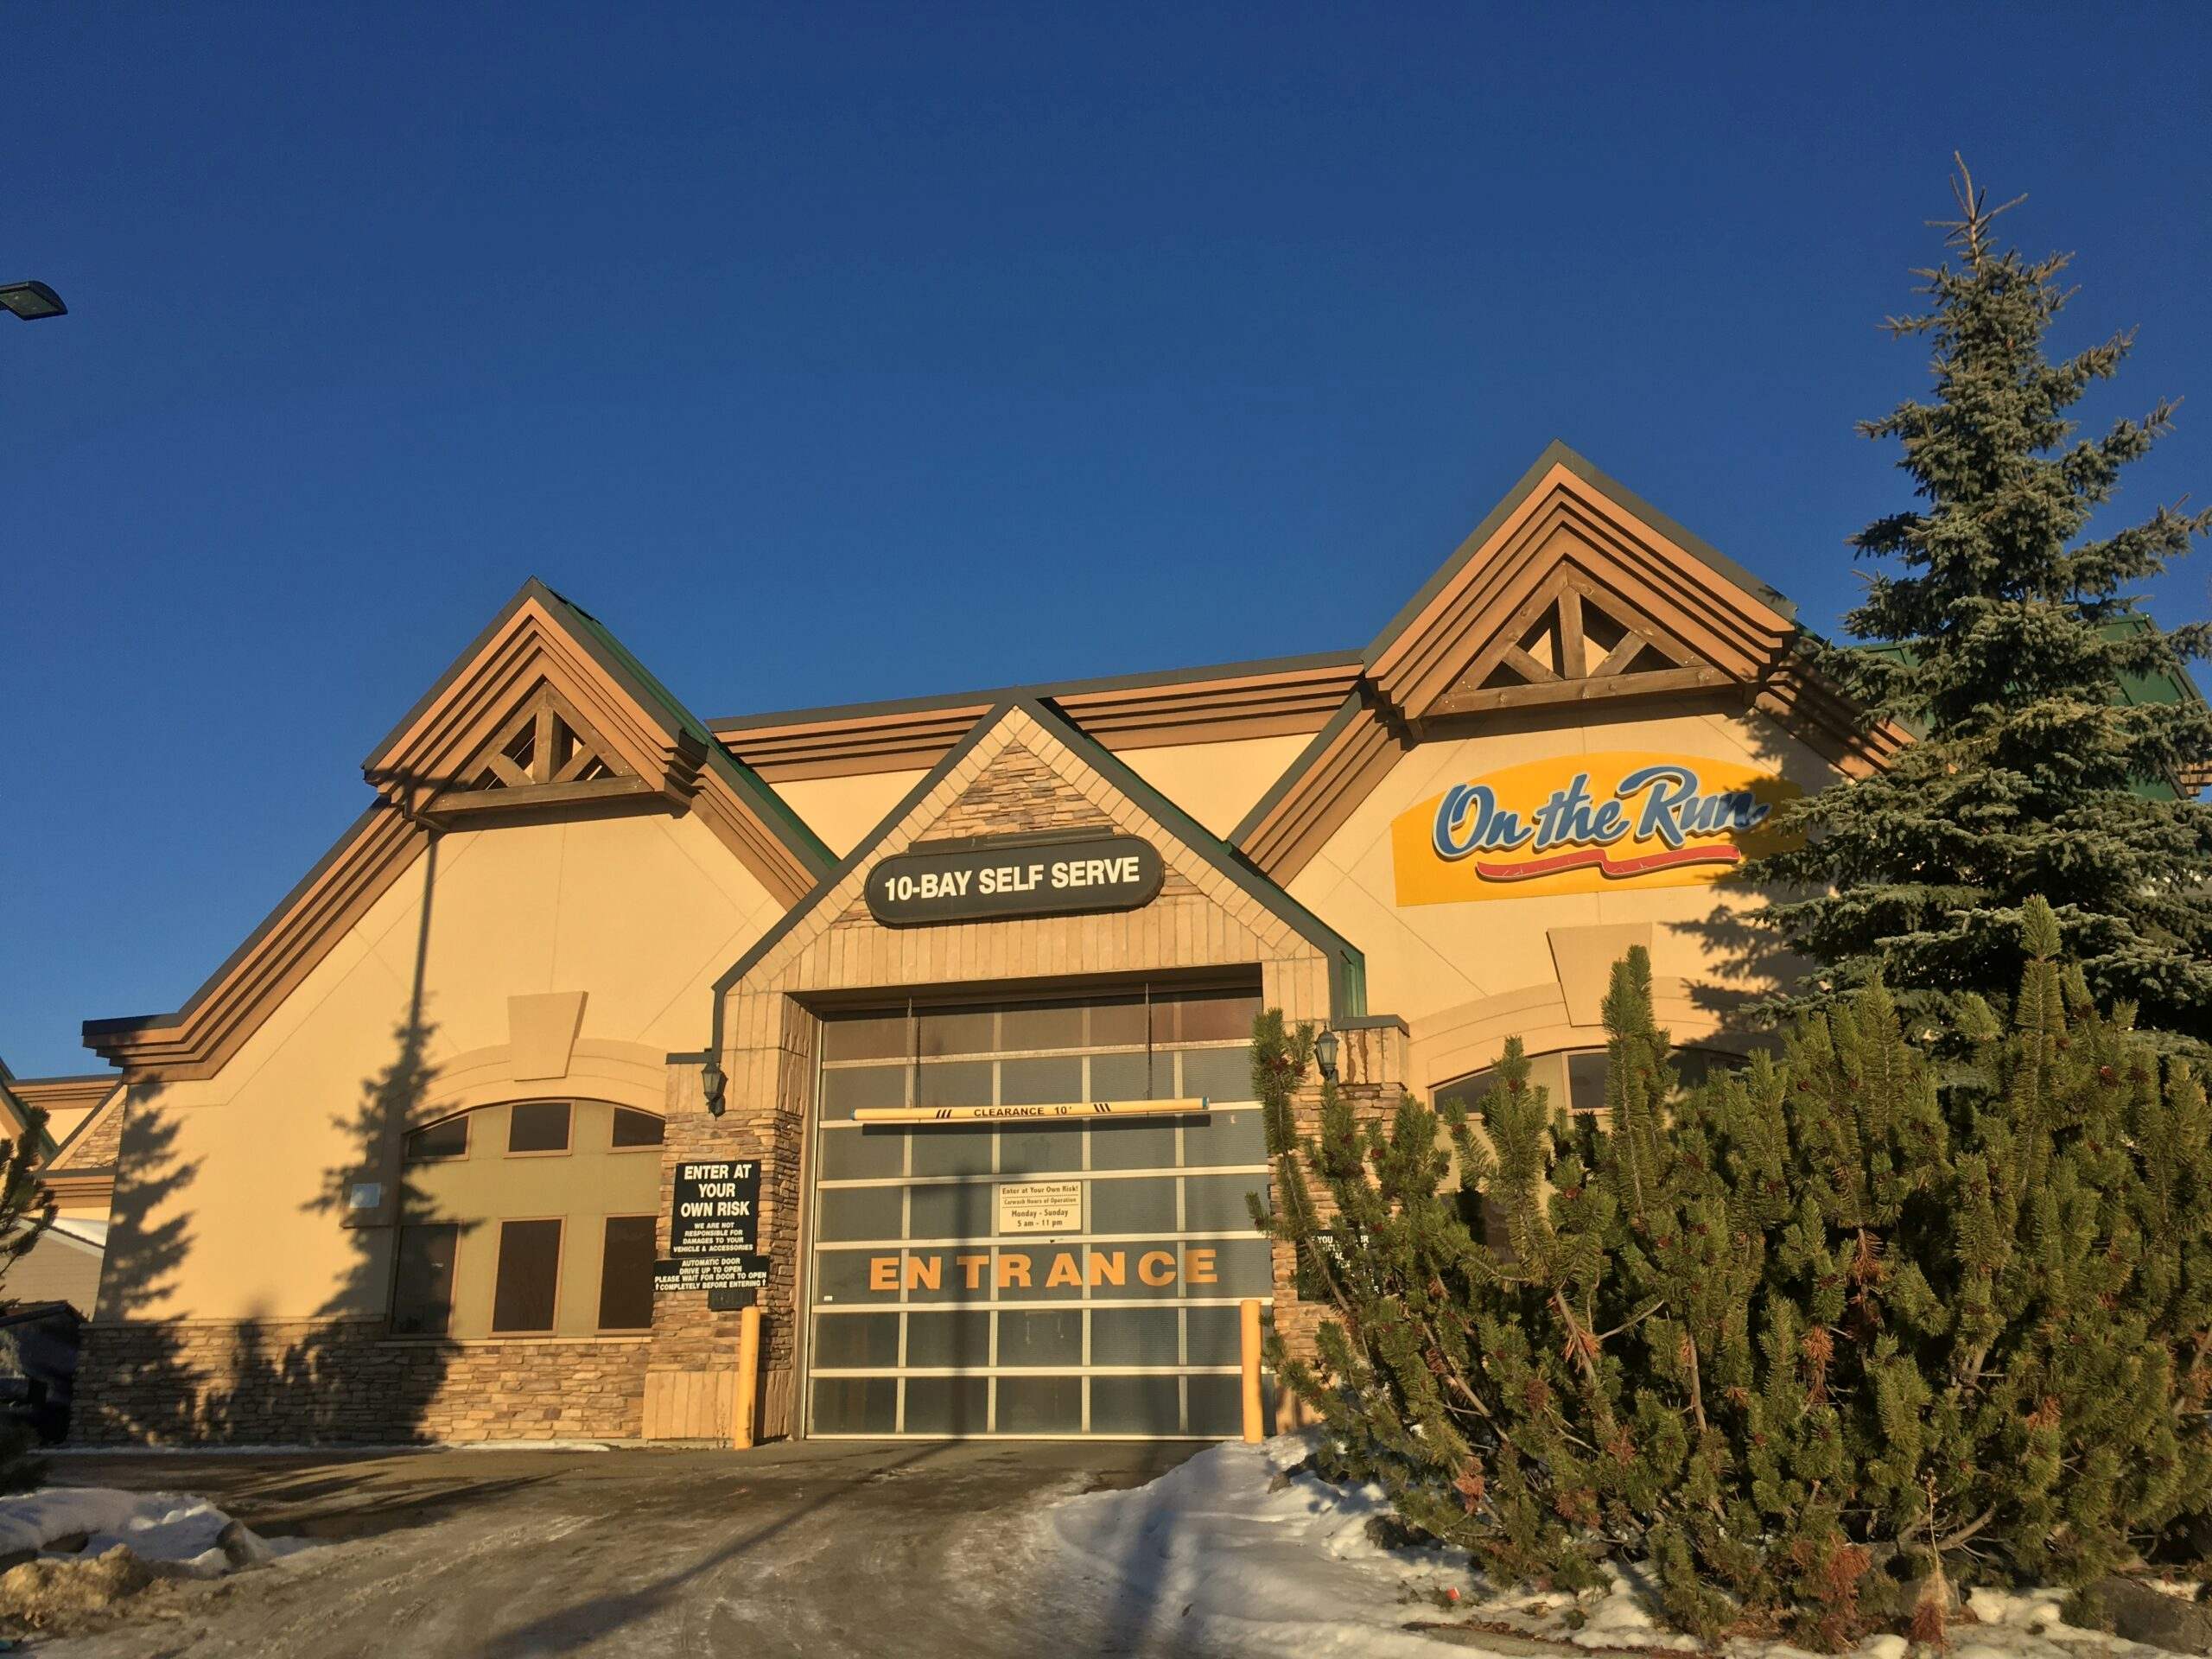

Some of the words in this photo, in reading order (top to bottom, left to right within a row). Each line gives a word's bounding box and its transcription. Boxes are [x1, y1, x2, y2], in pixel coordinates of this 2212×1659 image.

[1432, 783, 1535, 861] On
[1530, 769, 1631, 852] the
[1615, 764, 1772, 849] Run
[885, 870, 973, 902] 10-BAY
[978, 864, 1044, 894] SELF
[1051, 855, 1140, 888] SERVE
[974, 1107, 1045, 1117] CLEARANCE
[684, 1165, 728, 1179] ENTER
[734, 1164, 752, 1179] AT
[698, 1183, 736, 1198] YOUR
[681, 1202, 714, 1217] OWN
[717, 1201, 750, 1217] RISK
[1011, 1210, 1037, 1218] Monday
[1044, 1209, 1068, 1217] Sunday
[870, 1249, 1217, 1291] ENTRANCE
[659, 1282, 700, 1291] COMPLETELY
